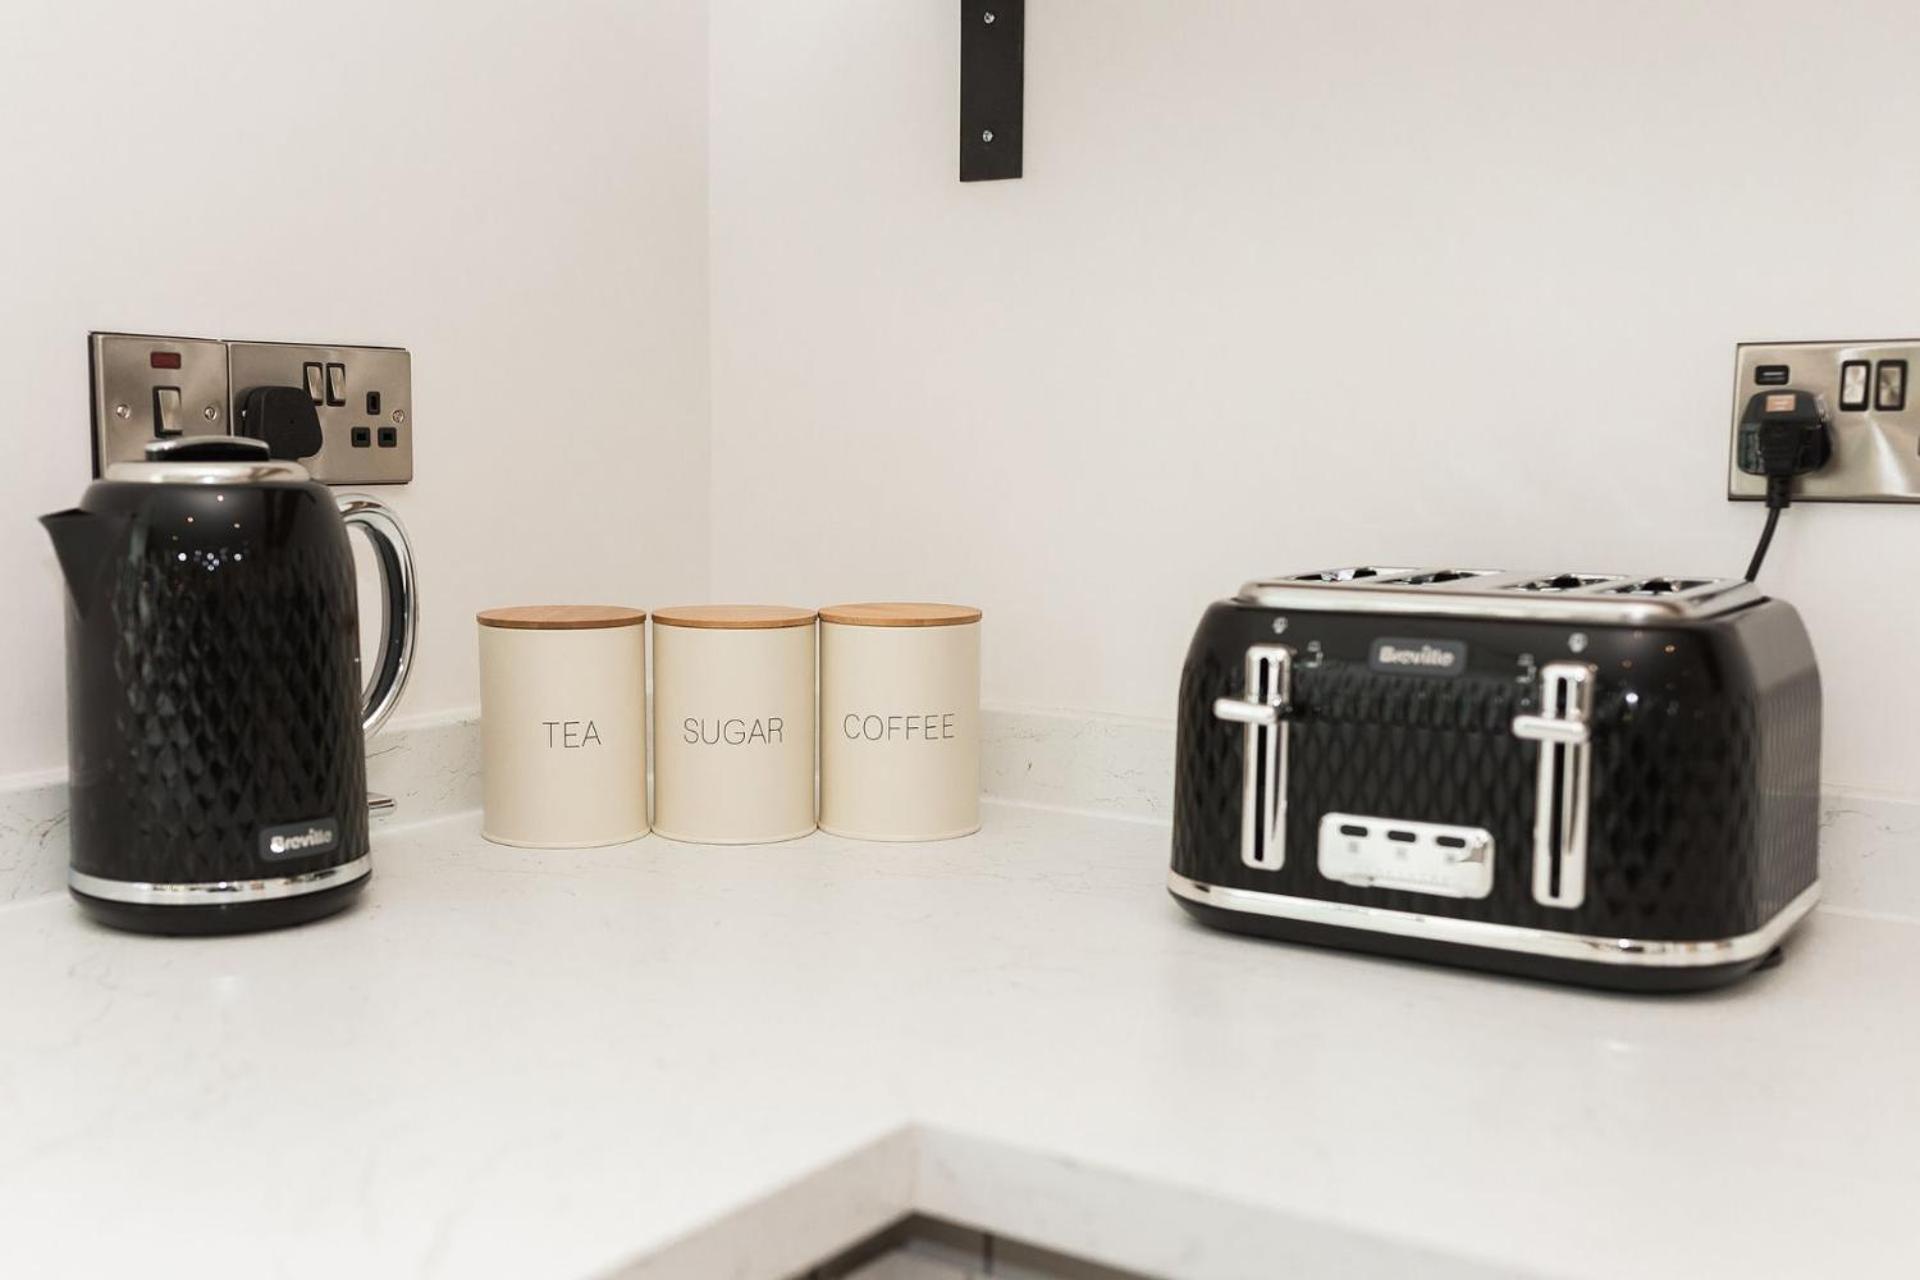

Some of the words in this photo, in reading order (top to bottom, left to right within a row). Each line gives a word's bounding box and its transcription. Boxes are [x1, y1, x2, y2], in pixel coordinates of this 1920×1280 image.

[542, 720, 602, 748] TEA
[683, 717, 783, 745] SUGAR
[843, 713, 956, 741] COFFEE
